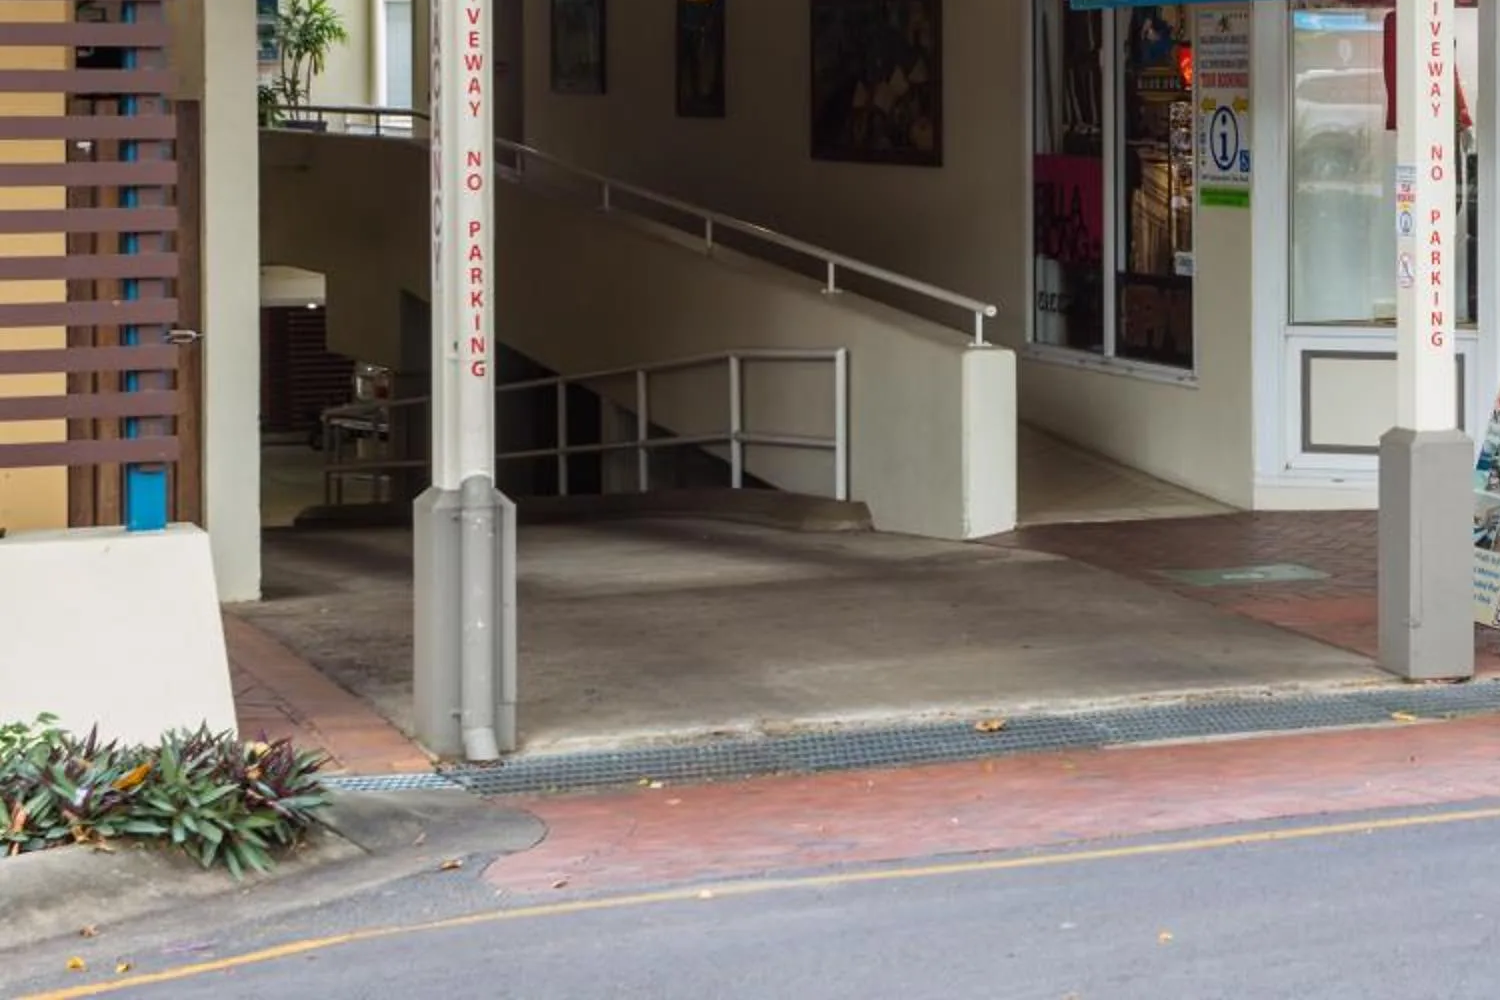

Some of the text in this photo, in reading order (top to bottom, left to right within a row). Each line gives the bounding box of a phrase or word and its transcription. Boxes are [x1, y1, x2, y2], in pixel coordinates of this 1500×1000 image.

[467, 151, 483, 191] NO
[1431, 145, 1444, 181] NO
[469, 221, 486, 378] PARKING
[1429, 209, 1444, 347] PARKING
